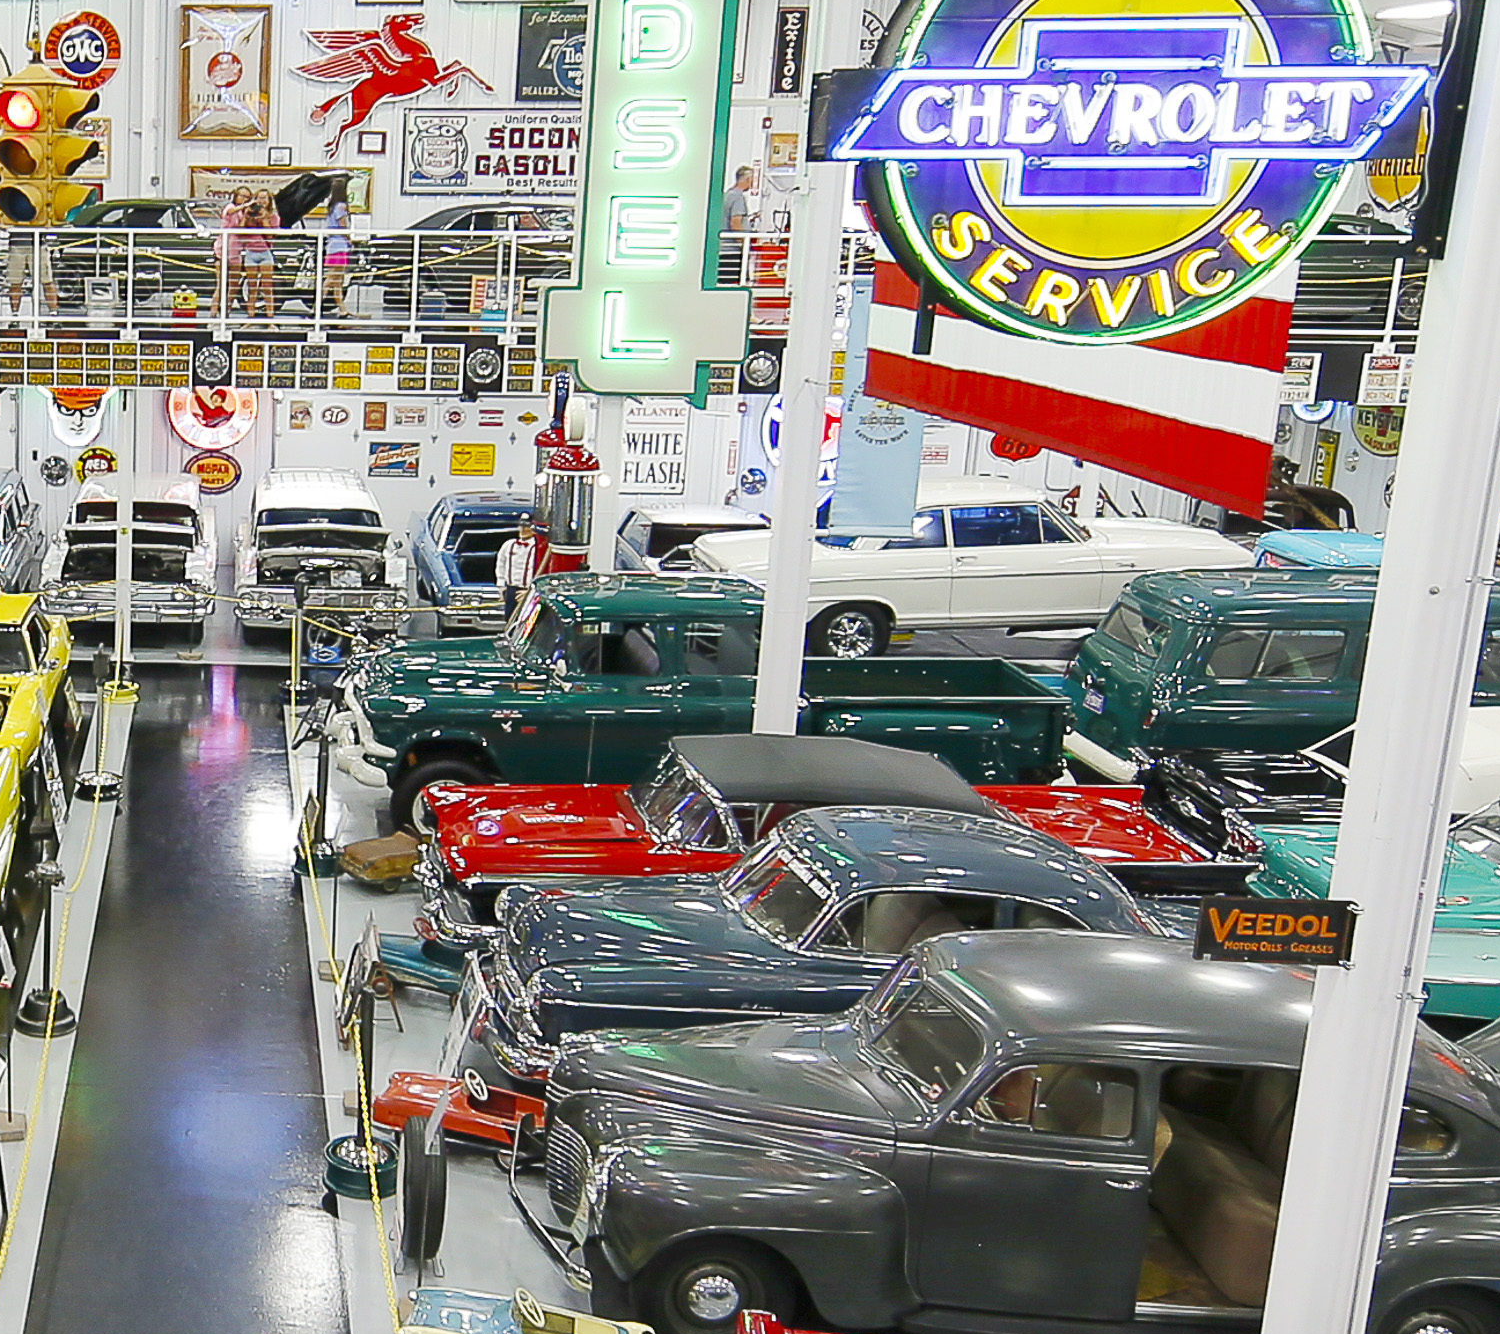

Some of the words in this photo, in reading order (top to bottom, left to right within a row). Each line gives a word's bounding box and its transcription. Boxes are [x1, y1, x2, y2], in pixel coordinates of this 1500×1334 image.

[60, 42, 103, 64] GMC
[782, 12, 801, 91] Exide
[504, 115, 548, 124] Uniform
[897, 79, 1374, 149] CHEVROLET
[506, 178, 534, 187] Best
[933, 208, 1290, 329] SERVICE
[322, 408, 349, 424] STP
[627, 407, 687, 418] ATLANTIC
[625, 431, 684, 456] WHITE
[1001, 439, 1029, 455] 66
[623, 461, 683, 485] FLASH
[1208, 906, 1338, 943] VEEDOL
[1224, 940, 1258, 952] MOTOR
[1259, 940, 1283, 953] OILS
[1290, 942, 1334, 954] GREASES
